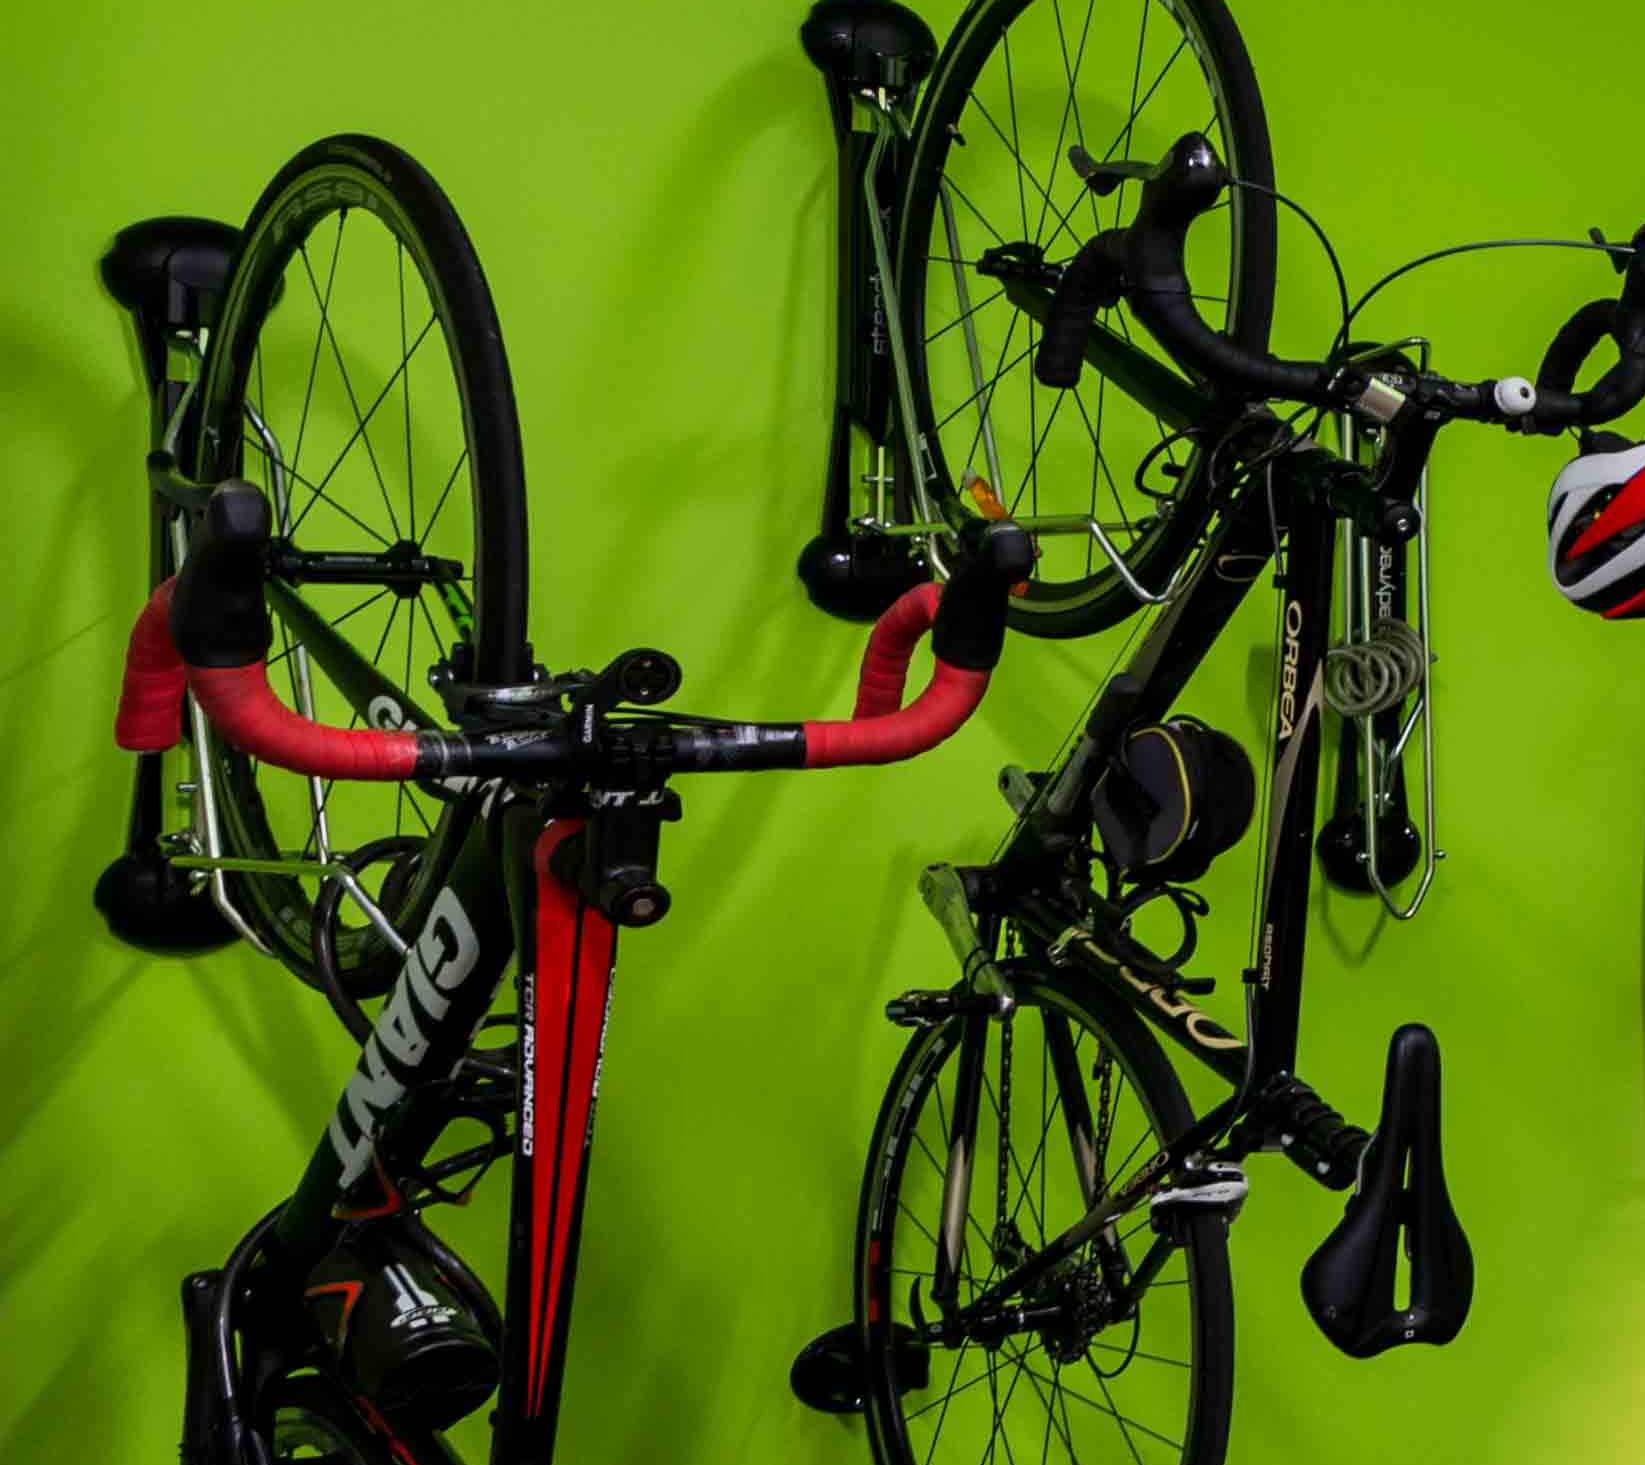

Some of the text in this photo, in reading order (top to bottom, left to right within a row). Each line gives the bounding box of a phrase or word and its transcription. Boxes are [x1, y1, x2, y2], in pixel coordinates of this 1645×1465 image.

[1278, 599, 1303, 742] ORBEA
[328, 885, 480, 1192] GIANT
[521, 1022, 536, 1158] ADVANCED
